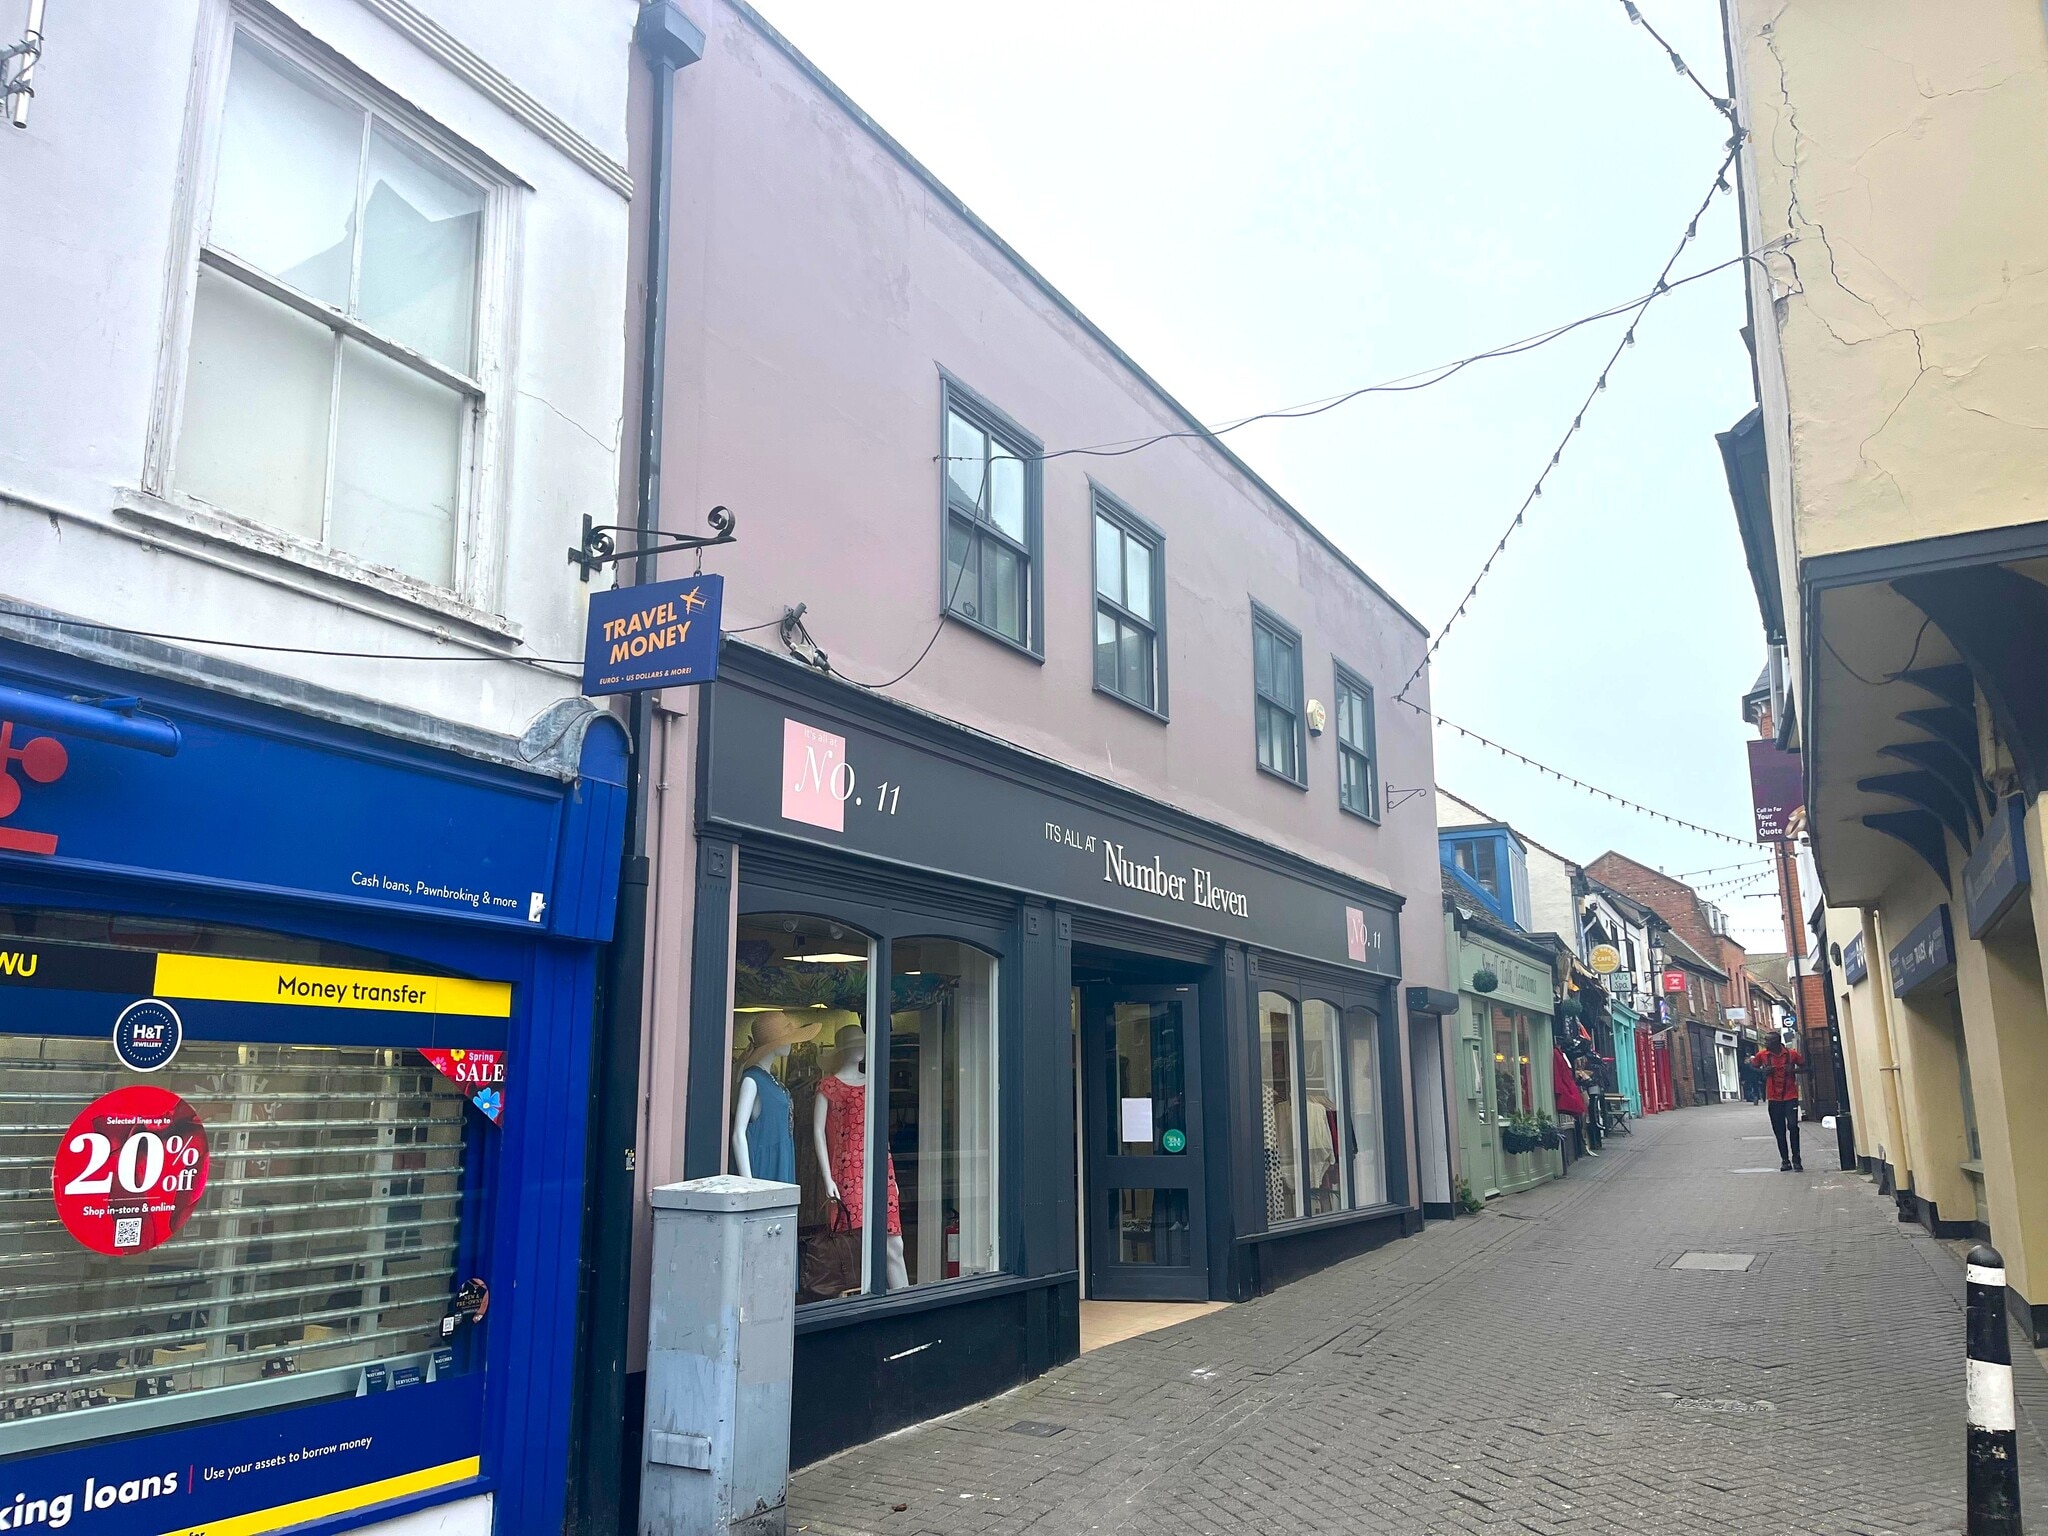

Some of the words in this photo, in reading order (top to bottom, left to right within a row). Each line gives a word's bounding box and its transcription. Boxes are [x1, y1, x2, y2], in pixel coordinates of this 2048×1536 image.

[604, 602, 677, 642] TRAVEL
[609, 621, 691, 665] MONEY
[599, 677, 620, 685] EUROS
[626, 674, 635, 682] US
[635, 670, 663, 681] DOLLARS
[670, 667, 692, 676] MORE!
[804, 727, 817, 740] It's
[818, 733, 828, 745] all
[829, 738, 838, 747] at
[877, 781, 900, 815] 11
[1759, 828, 1783, 837] Quote
[1761, 820, 1777, 828] Free
[1045, 822, 1061, 843] ITS
[1064, 829, 1082, 850] ALL
[1085, 835, 1097, 853] AT
[1103, 840, 1187, 902] Number
[1192, 867, 1249, 918] Eleven
[351, 871, 379, 888] Cash
[382, 875, 412, 895] loans,
[416, 881, 480, 907] Pawnbroking
[482, 891, 491, 904] &
[493, 896, 518, 908] more
[1373, 931, 1381, 949] 11
[0, 951, 38, 977] WU
[278, 975, 348, 1003] Money
[353, 983, 427, 1004] transfer
[1614, 980, 1629, 990] Spa
[133, 1024, 164, 1040] H&T
[469, 1052, 494, 1064] Spring
[455, 1062, 504, 1083] SALE
[106, 1116, 136, 1125] Selected
[137, 1116, 153, 1125] lines
[153, 1118, 162, 1126] up
[163, 1117, 171, 1125] to
[162, 1168, 198, 1192] off
[83, 1205, 105, 1219] Shop
[107, 1204, 140, 1215] in-store
[141, 1203, 149, 1212] &
[150, 1203, 176, 1212] online
[83, 1472, 178, 1512] loans
[204, 1468, 225, 1481] Use
[227, 1463, 253, 1481] your
[255, 1455, 287, 1470] assets
[288, 1452, 300, 1463] to
[302, 1444, 338, 1460] borrow
[339, 1436, 373, 1451] money
